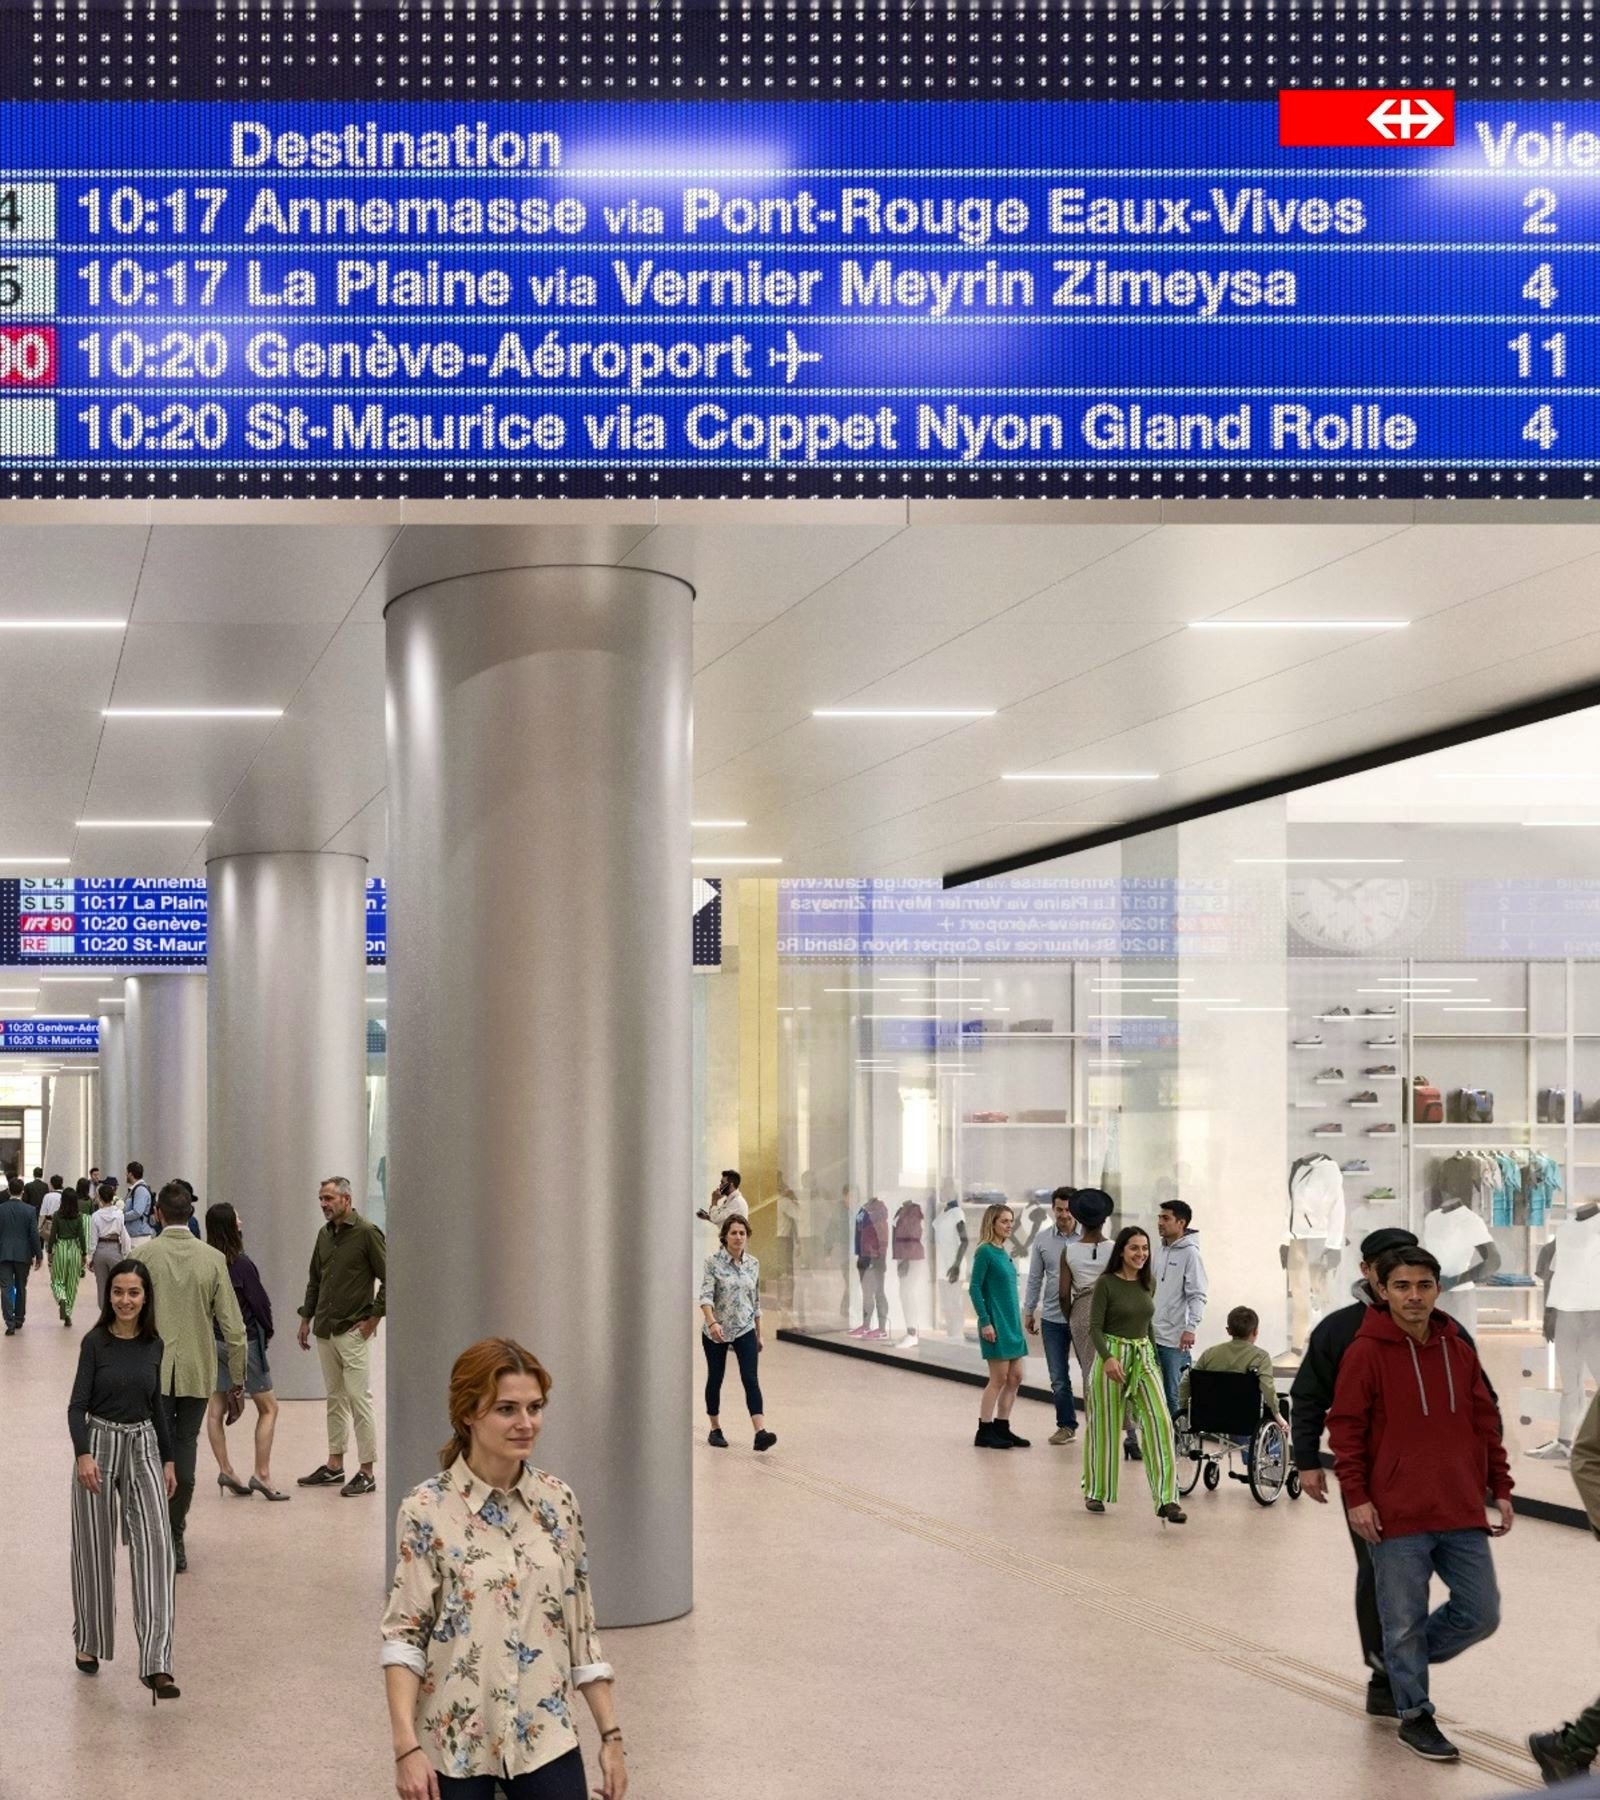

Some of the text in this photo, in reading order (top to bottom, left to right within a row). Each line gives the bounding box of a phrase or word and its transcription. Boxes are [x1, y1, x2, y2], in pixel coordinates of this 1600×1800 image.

[231, 121, 562, 168] Destination
[1474, 122, 1600, 168] Voie
[79, 187, 227, 234] 10:17
[245, 187, 587, 234] Annemasse
[604, 198, 663, 234] via
[684, 187, 1029, 247] Pont-Rouge
[1048, 187, 1366, 234] Eaux-Vives
[1521, 187, 1558, 233] 2
[79, 260, 227, 306] 10:17
[248, 260, 316, 306] La
[337, 260, 510, 306] Plaine
[529, 268, 596, 306] via
[613, 260, 821, 306] Vernier
[840, 260, 1034, 317] Meyrin
[1051, 260, 1297, 318] Zimeysa
[1523, 262, 1558, 308] 4
[79, 330, 228, 378] 10:20
[246, 328, 752, 390] Genève-Aéroport
[1509, 332, 1566, 377] 11
[79, 403, 228, 449] 10:20
[246, 403, 565, 449] St-Maurice
[584, 404, 665, 449] via
[685, 403, 897, 463] Coppet
[915, 404, 1063, 463] Nyon
[1081, 403, 1250, 449] Gland
[1272, 404, 1416, 449] Rolle
[1523, 404, 1558, 449] 4
[81, 878, 128, 889] 10:17
[24, 895, 207, 910] S L5 10:17 La Plain
[51, 917, 73, 931] 90
[81, 917, 128, 931] 10:20
[23, 937, 207, 952] RE 10:20 St-Maur
[8, 1023, 35, 1033] 10:20
[8, 1035, 35, 1045] 10:20
[37, 1035, 93, 1045] St-Maurice
